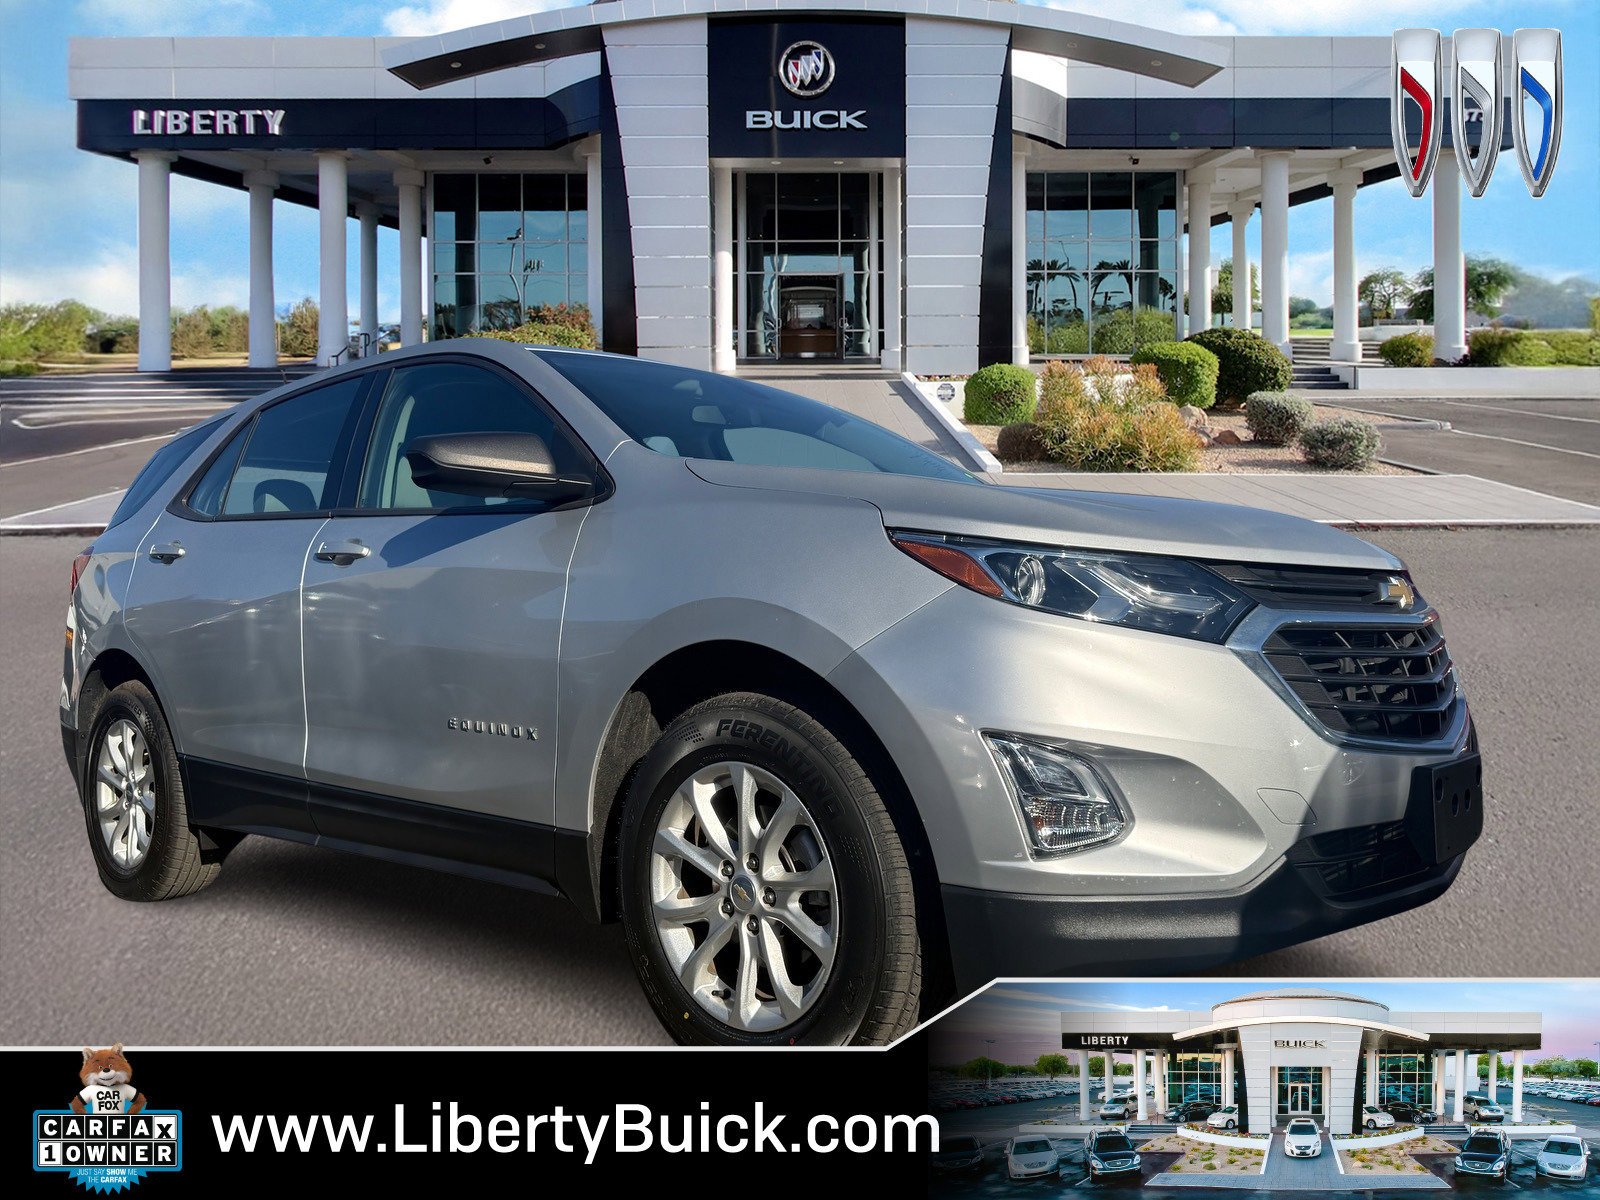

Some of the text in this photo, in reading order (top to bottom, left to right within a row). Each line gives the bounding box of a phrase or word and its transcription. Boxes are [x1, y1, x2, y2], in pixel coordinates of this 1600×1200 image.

[132, 109, 286, 136] LIBERTY
[745, 110, 868, 129] BUICK
[448, 716, 539, 741] EQUINOX
[1081, 1035, 1129, 1045] LIBERTY
[1273, 1039, 1328, 1049] BUICK
